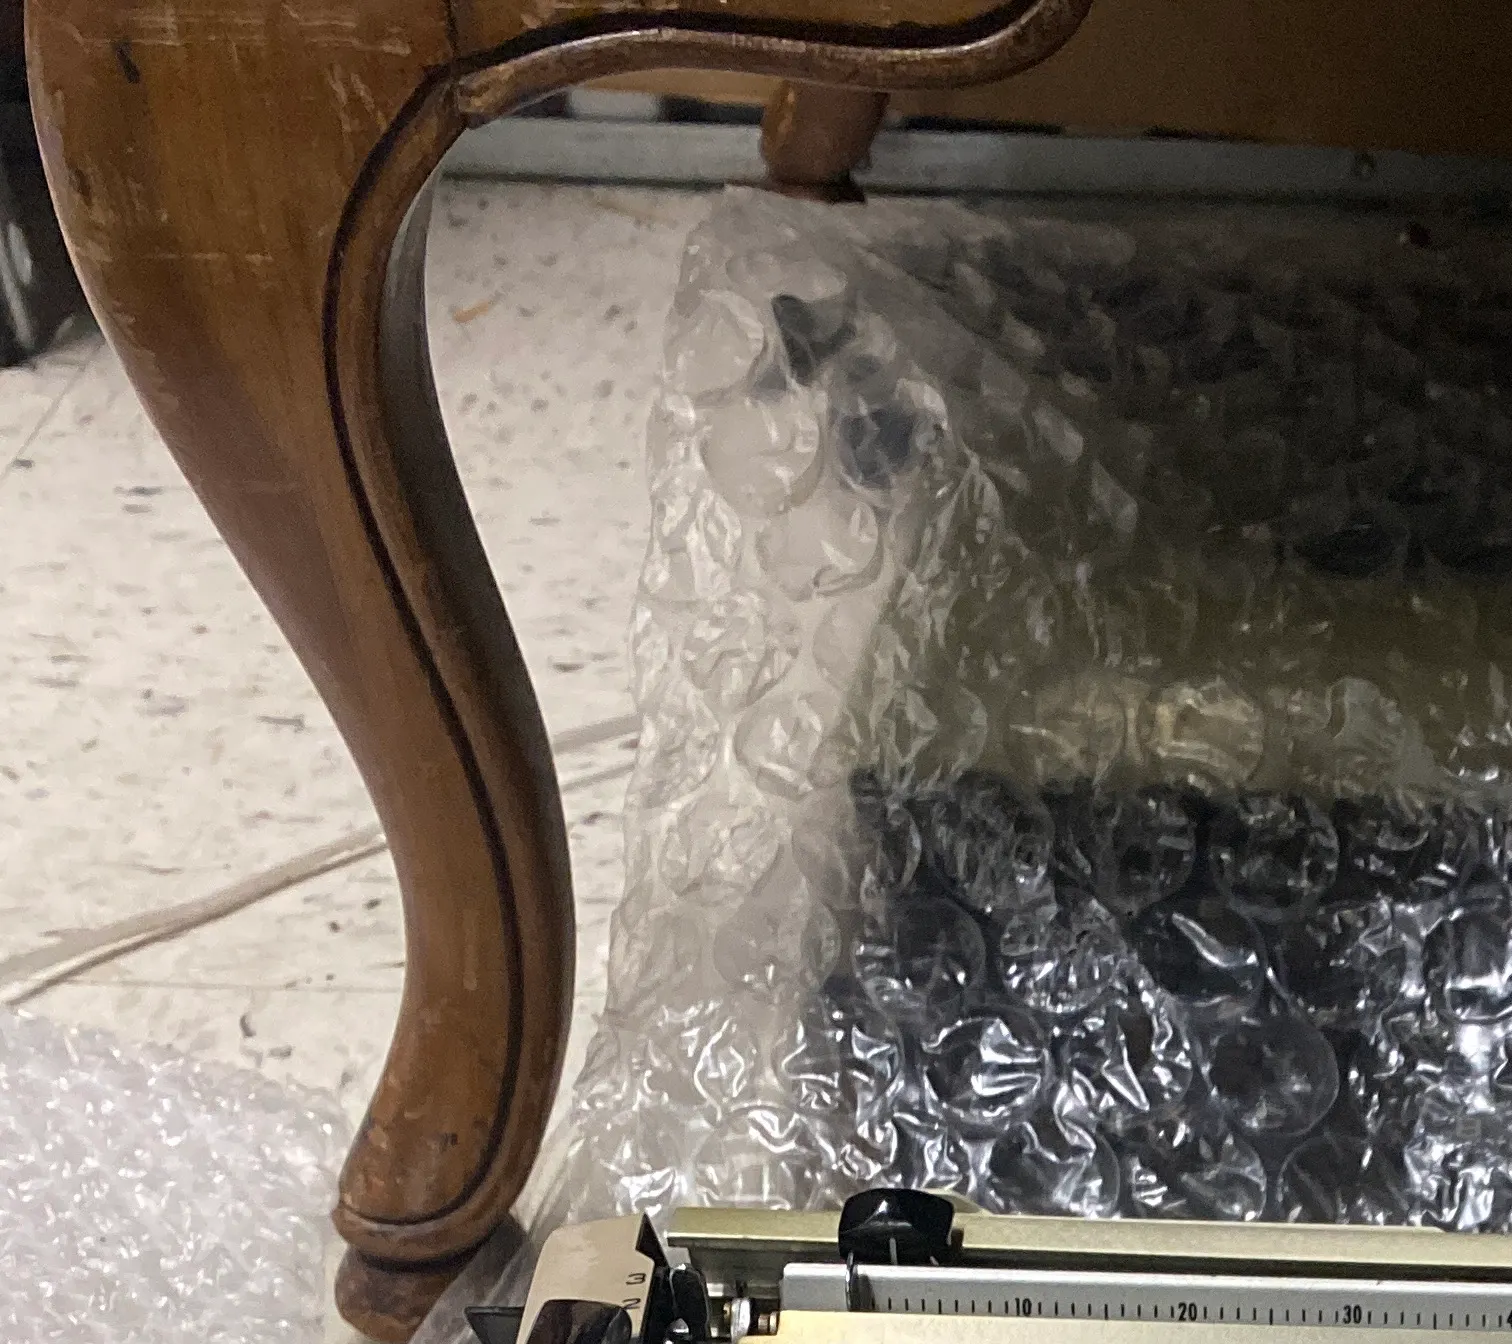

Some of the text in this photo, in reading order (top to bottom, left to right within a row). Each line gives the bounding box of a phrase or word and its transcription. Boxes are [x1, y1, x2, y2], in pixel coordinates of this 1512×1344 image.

[626, 1272, 646, 1285] 3
[1015, 1297, 1032, 1317] 10
[1178, 1302, 1198, 1322] 20
[1343, 1305, 1362, 1325] 30
